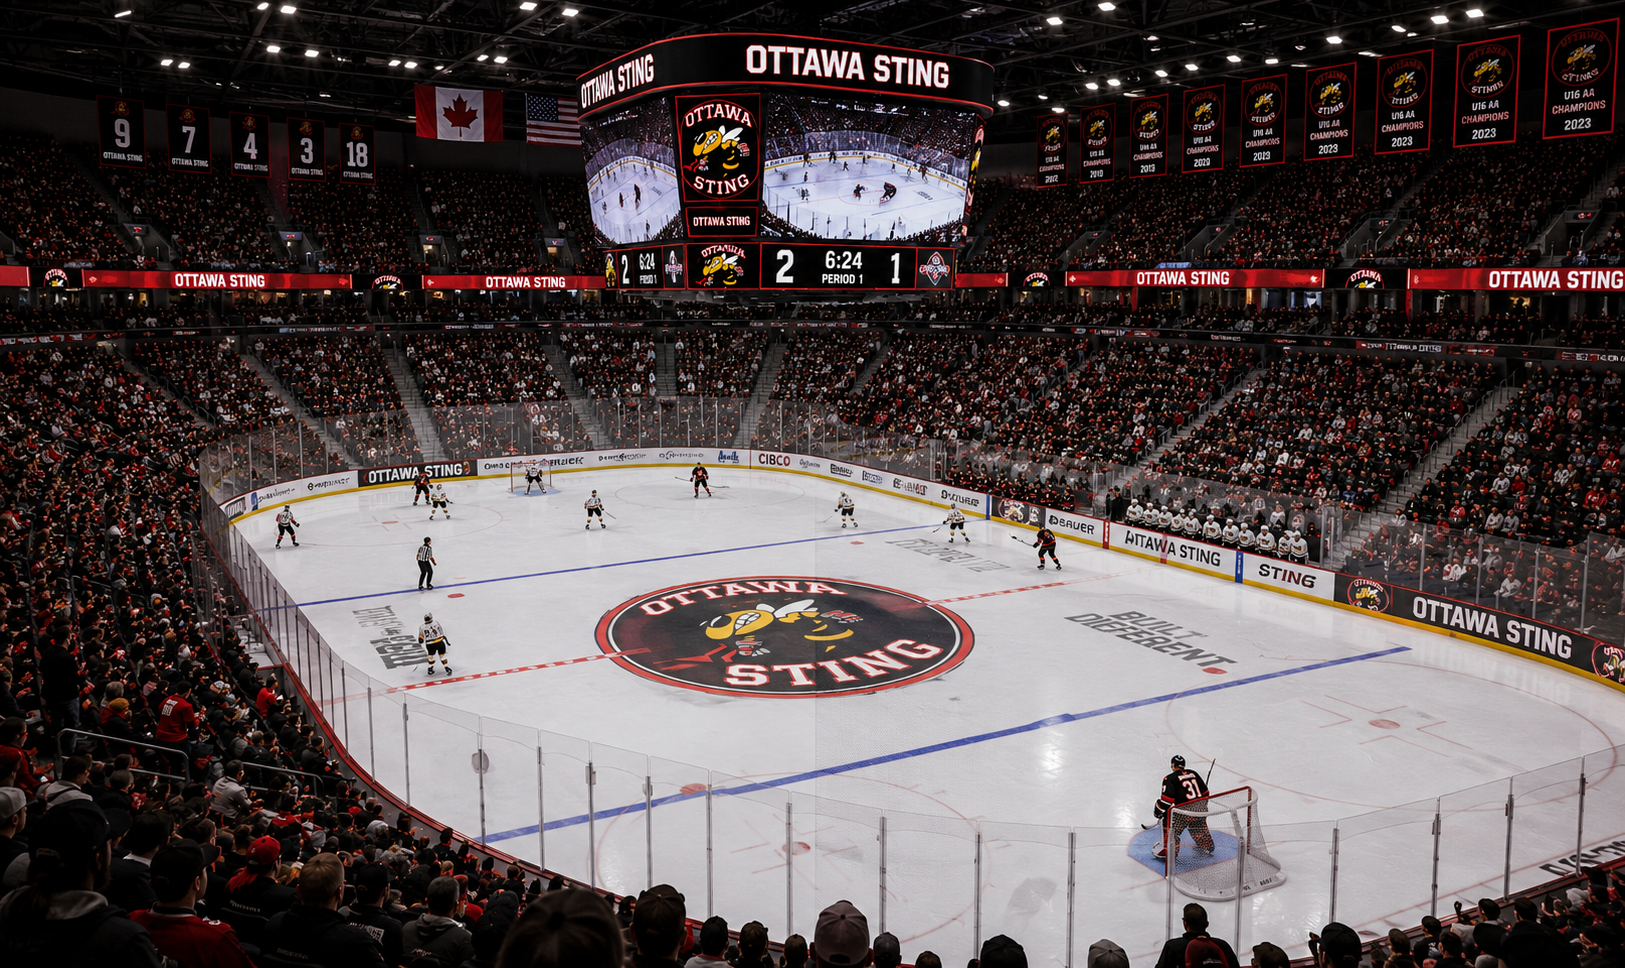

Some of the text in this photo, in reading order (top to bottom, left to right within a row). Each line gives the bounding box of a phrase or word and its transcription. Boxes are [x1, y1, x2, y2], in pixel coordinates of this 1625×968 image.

[745, 44, 950, 89] OTTAWA STING
[581, 53, 655, 109] OTTAWA STING
[1564, 88, 1595, 100] U16 AA
[685, 103, 752, 128] OTTAWA
[1461, 111, 1509, 124] CHAMPIONS
[1472, 101, 1487, 112] U16
[1552, 100, 1606, 115] CHAMPIONS
[114, 118, 131, 148] 9
[1472, 128, 1497, 140] 2023
[1564, 118, 1592, 131] 2023
[182, 125, 196, 154] 7
[243, 132, 258, 160] 4
[300, 137, 314, 164] 3
[1391, 136, 1413, 148] 2023
[346, 141, 369, 168] 18
[693, 173, 749, 195] STING
[693, 215, 751, 227] OTTAWA STING
[621, 254, 630, 285] 2
[639, 252, 655, 271] 6:24
[775, 249, 794, 284] 2
[825, 250, 863, 270] 6:24
[891, 252, 900, 284] 1
[175, 273, 265, 287] OTTAWA STING
[485, 276, 566, 288] OTTAWA STING
[822, 273, 864, 285] PERIOD 1
[1136, 270, 1230, 285] OTTAWA STING
[1488, 269, 1625, 290] OTTAWA STING
[758, 453, 791, 467] CIBCO
[368, 466, 420, 484] OTTAWA
[424, 463, 463, 478] STING
[1179, 544, 1221, 567] STING
[1258, 563, 1317, 589] STING
[640, 580, 848, 616] OTTAWA
[1108, 610, 1208, 640] BUILT
[1412, 596, 1573, 660] OTTAWA STING
[724, 638, 945, 687] STING
[1182, 778, 1203, 800] 31
